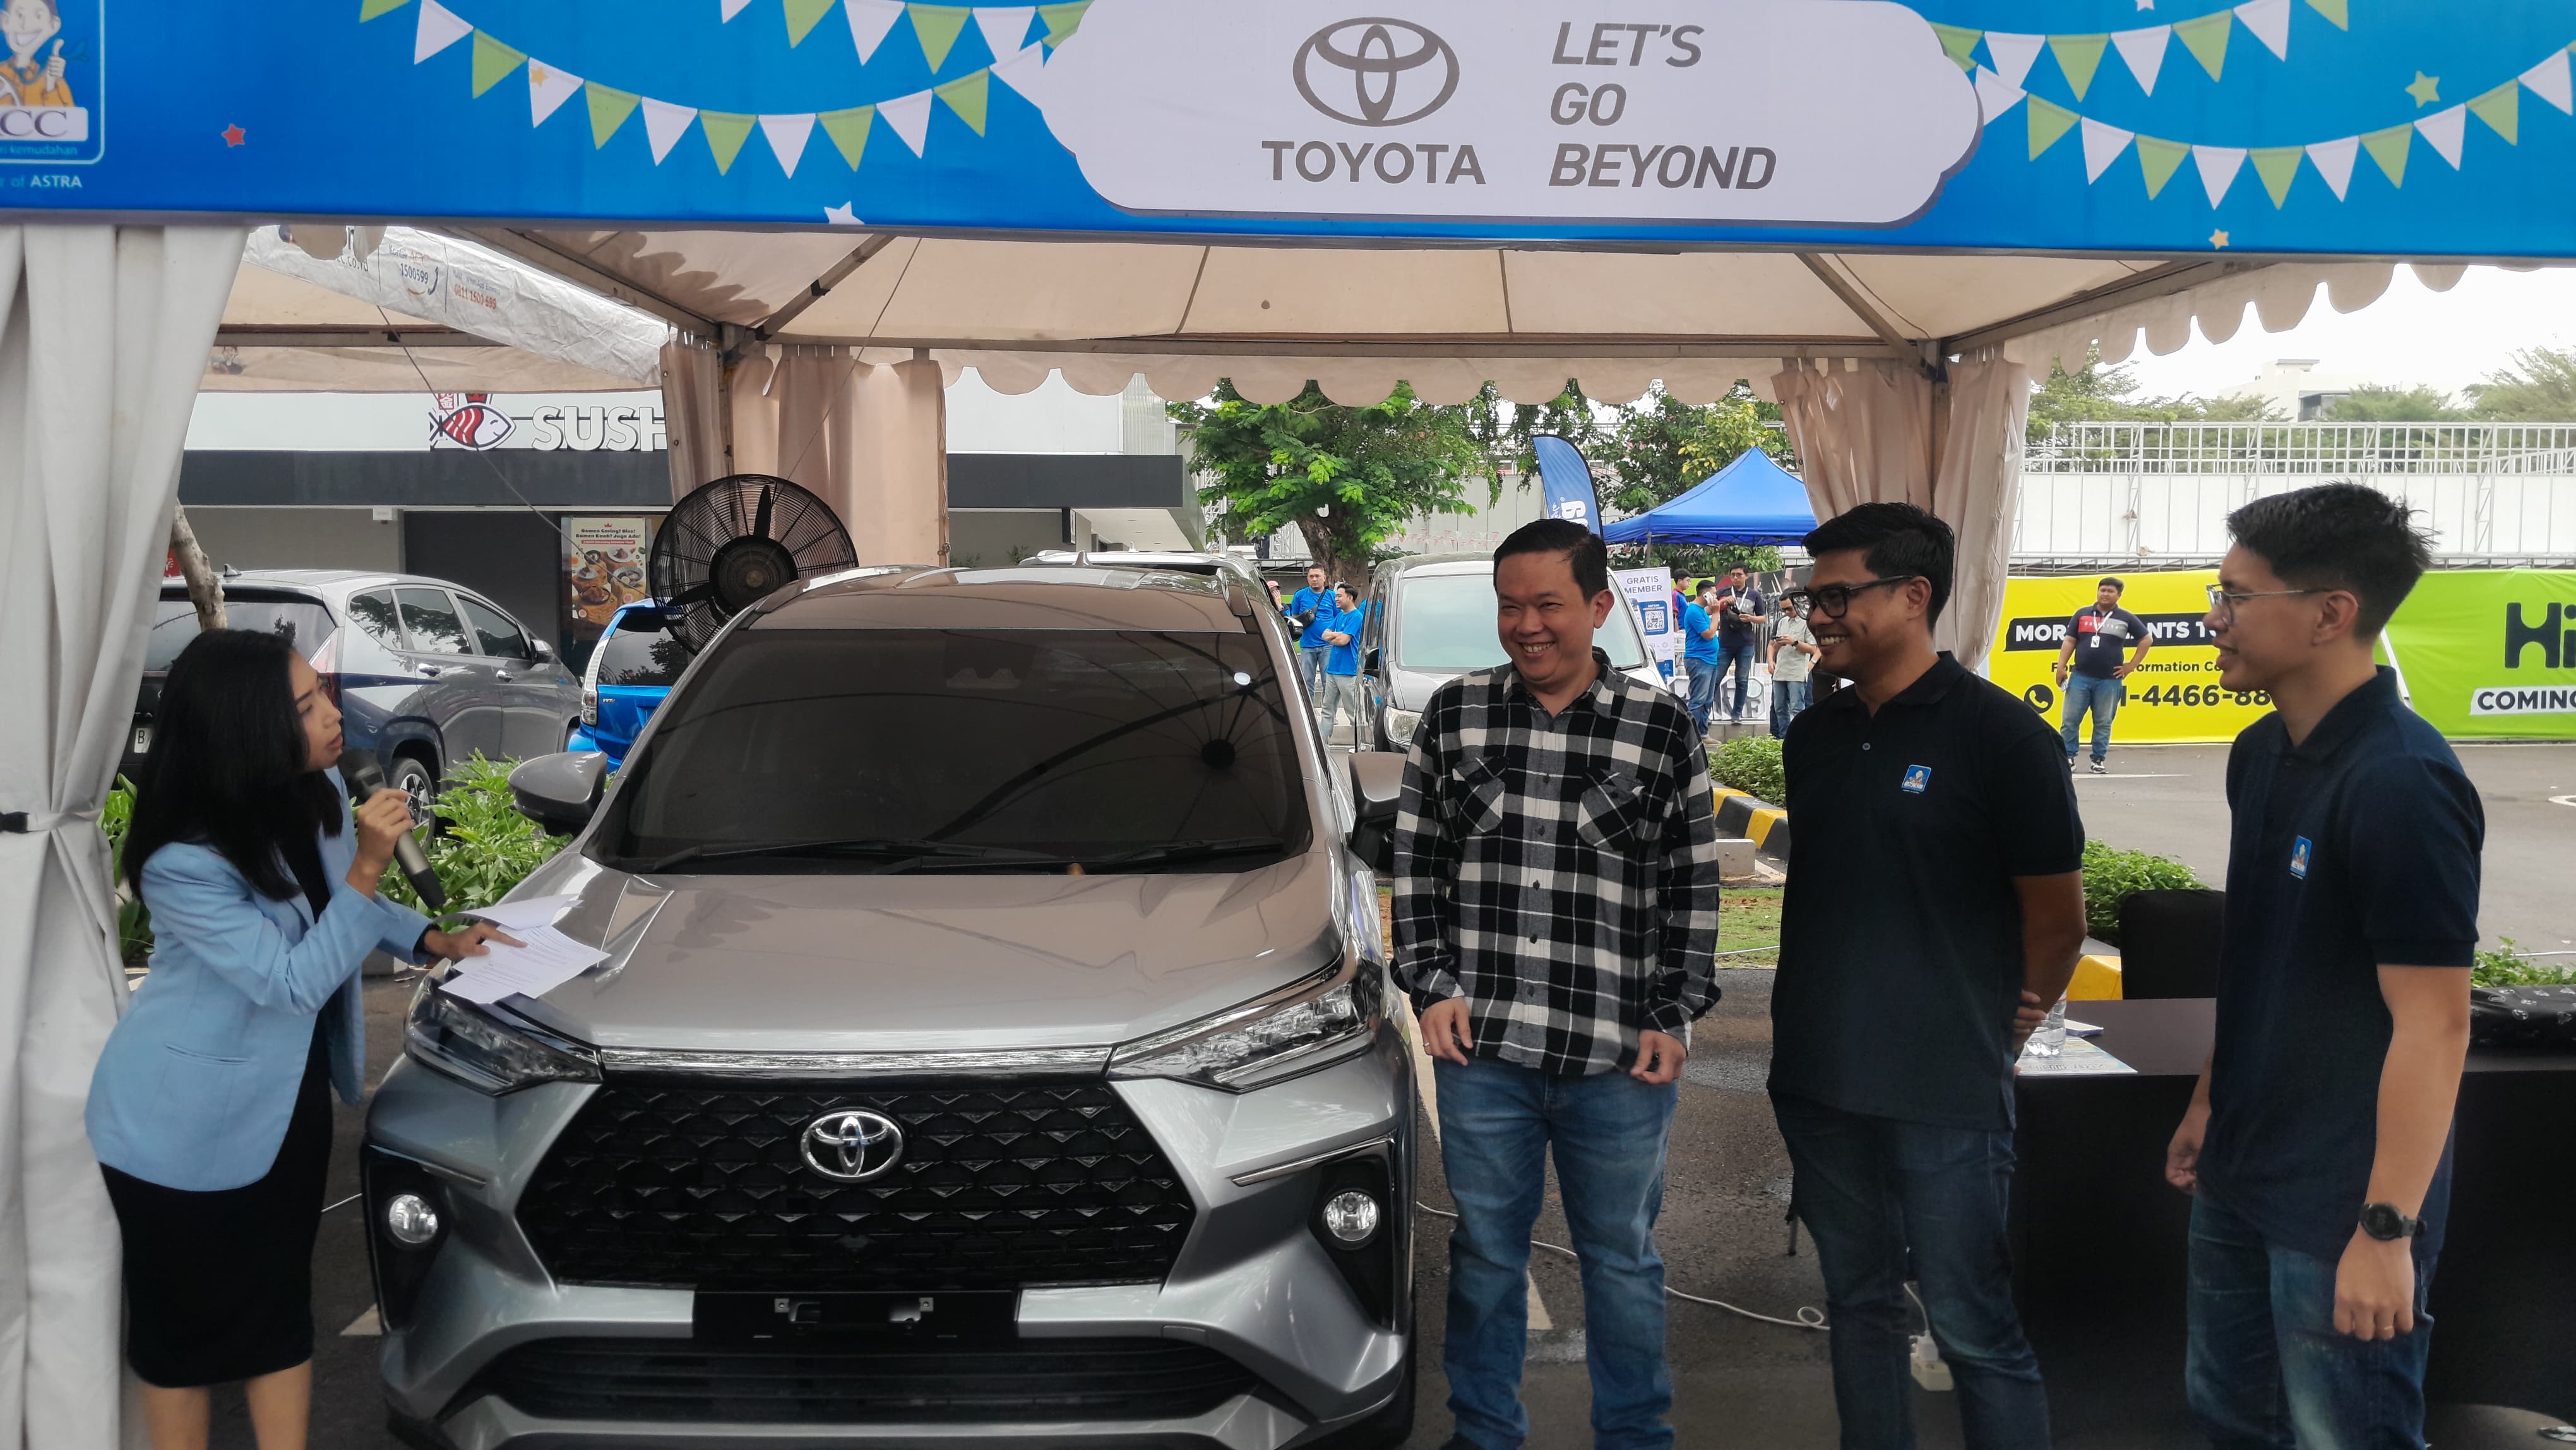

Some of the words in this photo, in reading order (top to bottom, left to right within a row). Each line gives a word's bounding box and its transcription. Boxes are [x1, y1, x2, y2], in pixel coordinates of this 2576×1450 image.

[1552, 21, 1705, 68] LET'S
[1550, 82, 1627, 126] GO
[0, 109, 68, 137] CC
[9, 145, 78, 156] kemudahan
[1261, 141, 1486, 184] TOYOTA
[1549, 143, 1777, 190] BEYOND
[30, 174, 83, 188] ASTRA
[400, 263, 429, 285] 1500599
[1625, 585, 1662, 594] MEMBER
[1626, 576, 1659, 585] GRATIS
